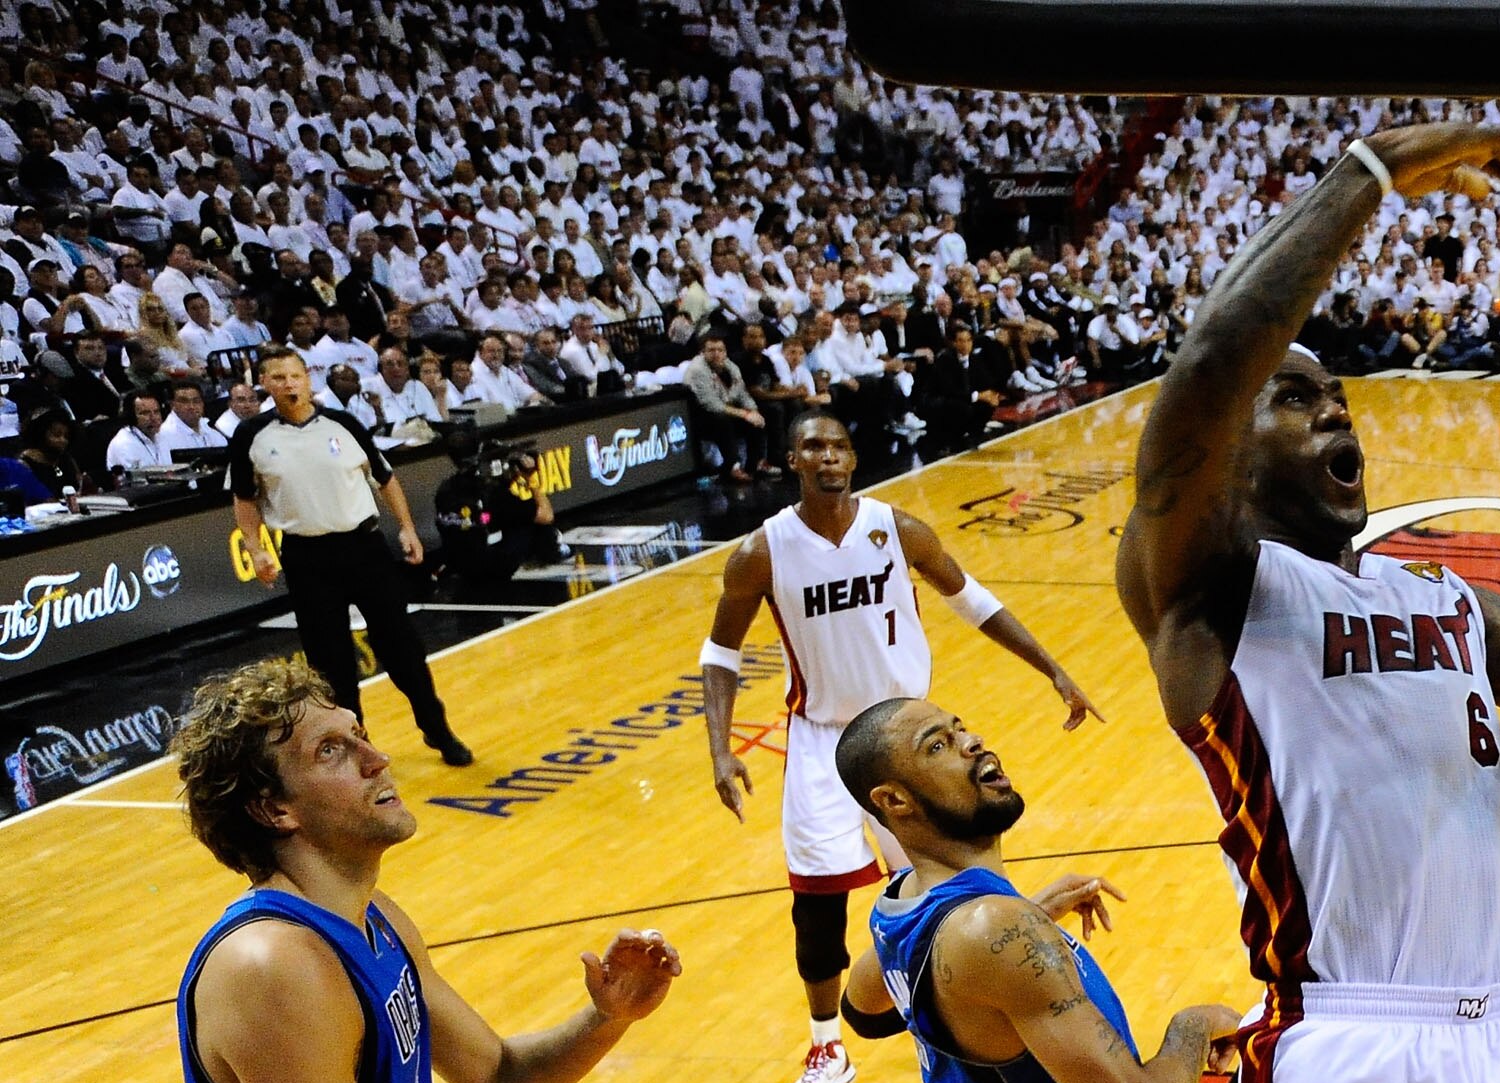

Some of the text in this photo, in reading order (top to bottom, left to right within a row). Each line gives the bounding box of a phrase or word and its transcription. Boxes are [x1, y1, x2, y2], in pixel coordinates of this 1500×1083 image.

[596, 424, 668, 486] Finals
[142, 556, 181, 586] abc
[803, 559, 894, 618] HEAT
[0, 562, 141, 661] Finals
[884, 609, 896, 646] 1
[1323, 592, 1473, 679] HEAT
[1466, 691, 1500, 768] 6
[1456, 993, 1490, 1019] MH
